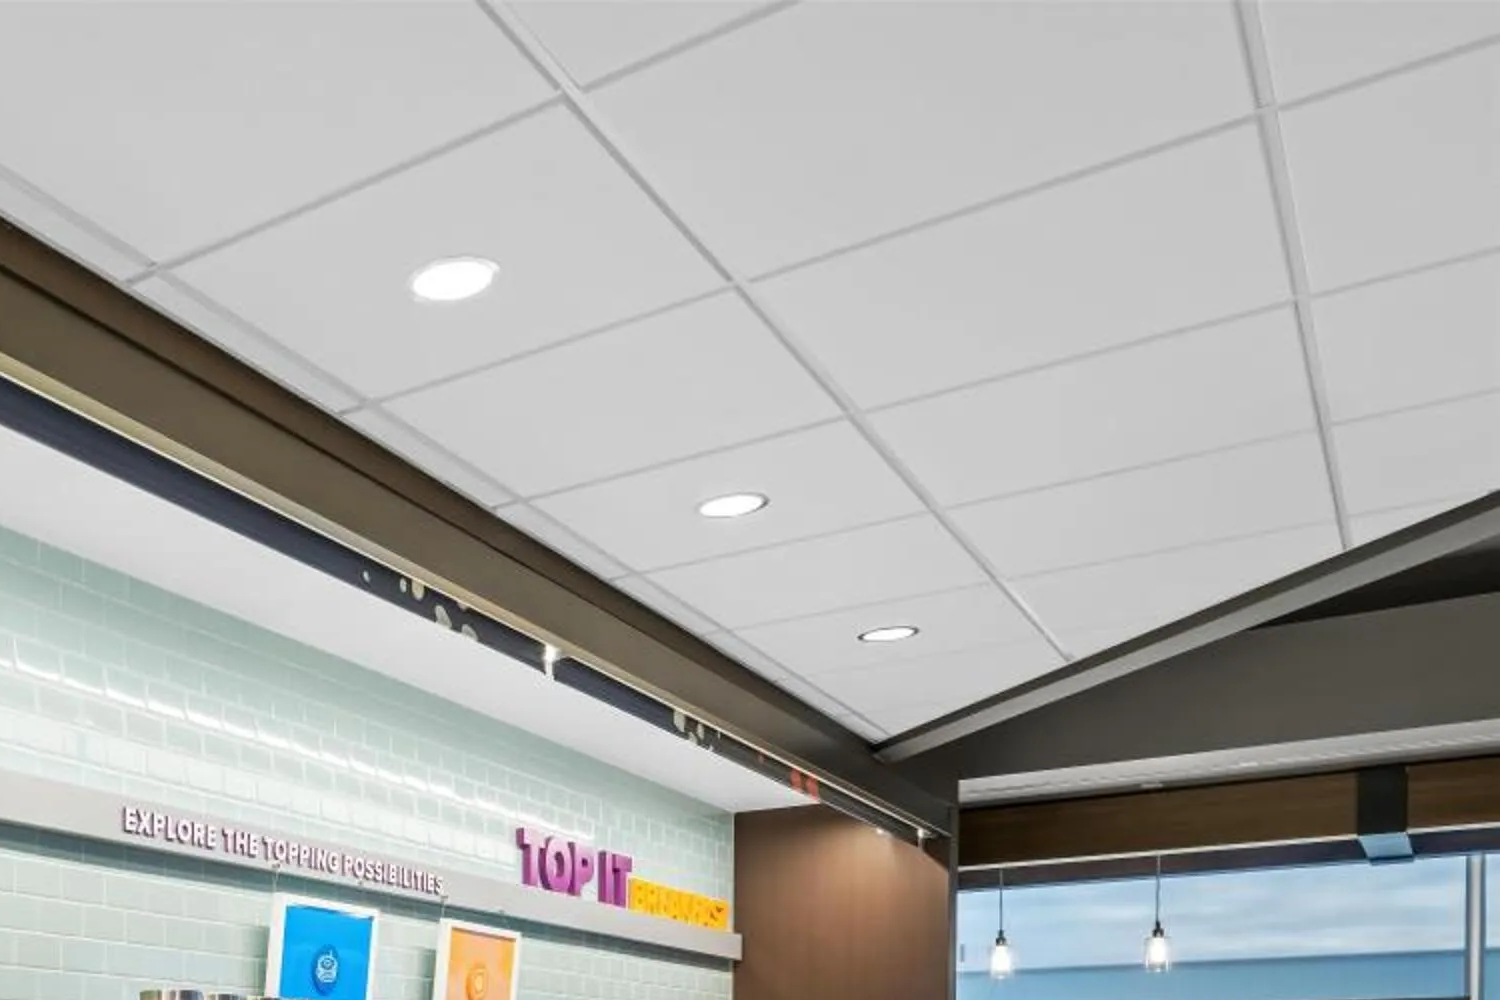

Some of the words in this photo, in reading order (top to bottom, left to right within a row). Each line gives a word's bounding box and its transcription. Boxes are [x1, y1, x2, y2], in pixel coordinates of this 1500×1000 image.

[122, 806, 217, 849] EXPLORE
[221, 827, 258, 859] THE
[263, 836, 340, 876] TOPPING
[342, 853, 445, 896] POSSIBILITIES
[516, 827, 595, 897] TOP
[598, 850, 633, 908] IT
